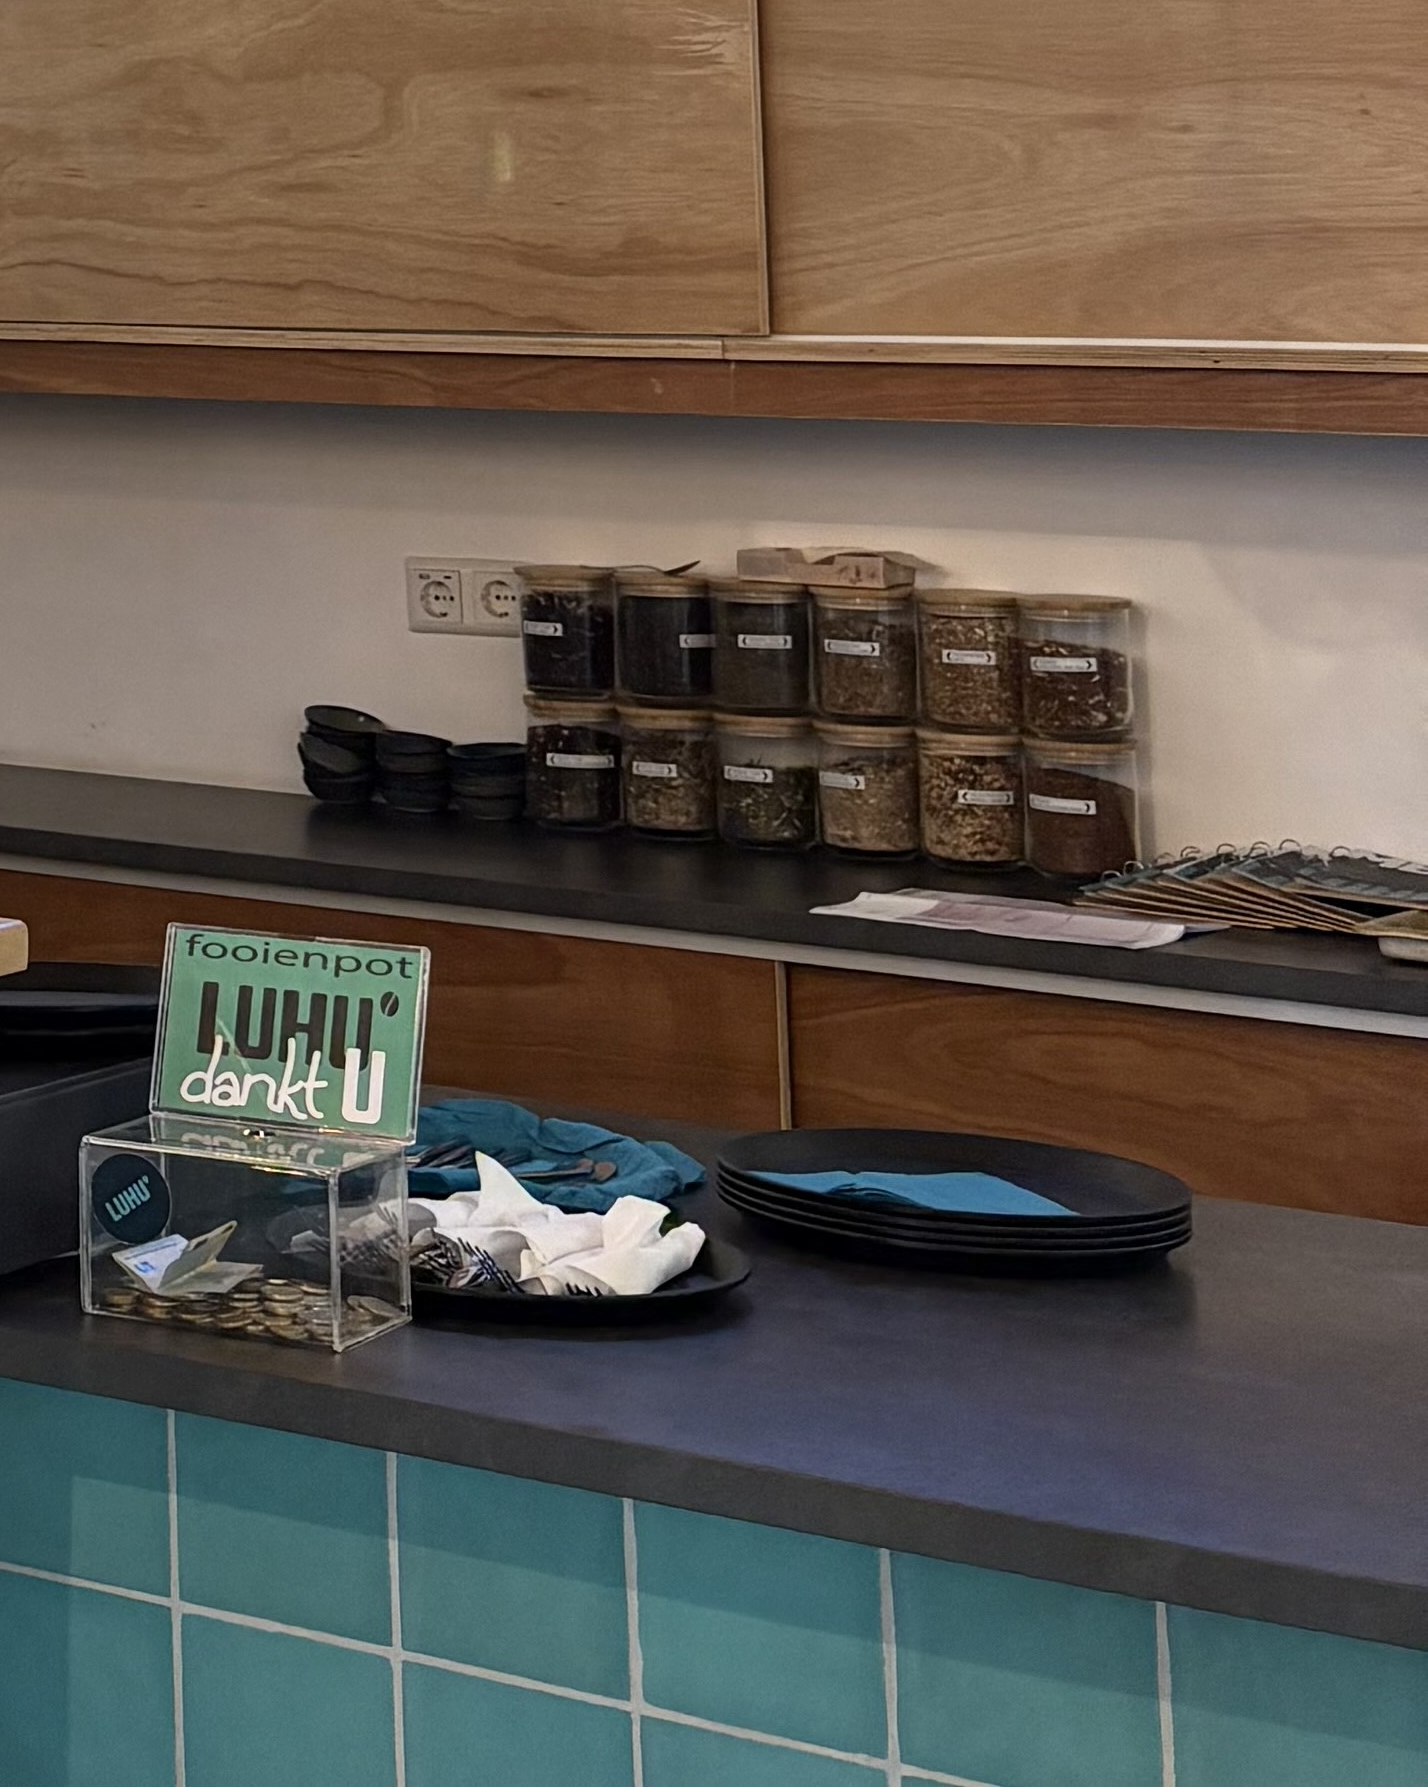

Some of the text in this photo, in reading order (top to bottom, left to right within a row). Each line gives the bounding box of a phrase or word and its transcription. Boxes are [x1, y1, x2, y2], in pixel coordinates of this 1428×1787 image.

[185, 933, 414, 979] fooienpot
[197, 981, 374, 1072] LUHU
[180, 1037, 387, 1125] dankt U
[104, 1178, 151, 1223] LUHU
